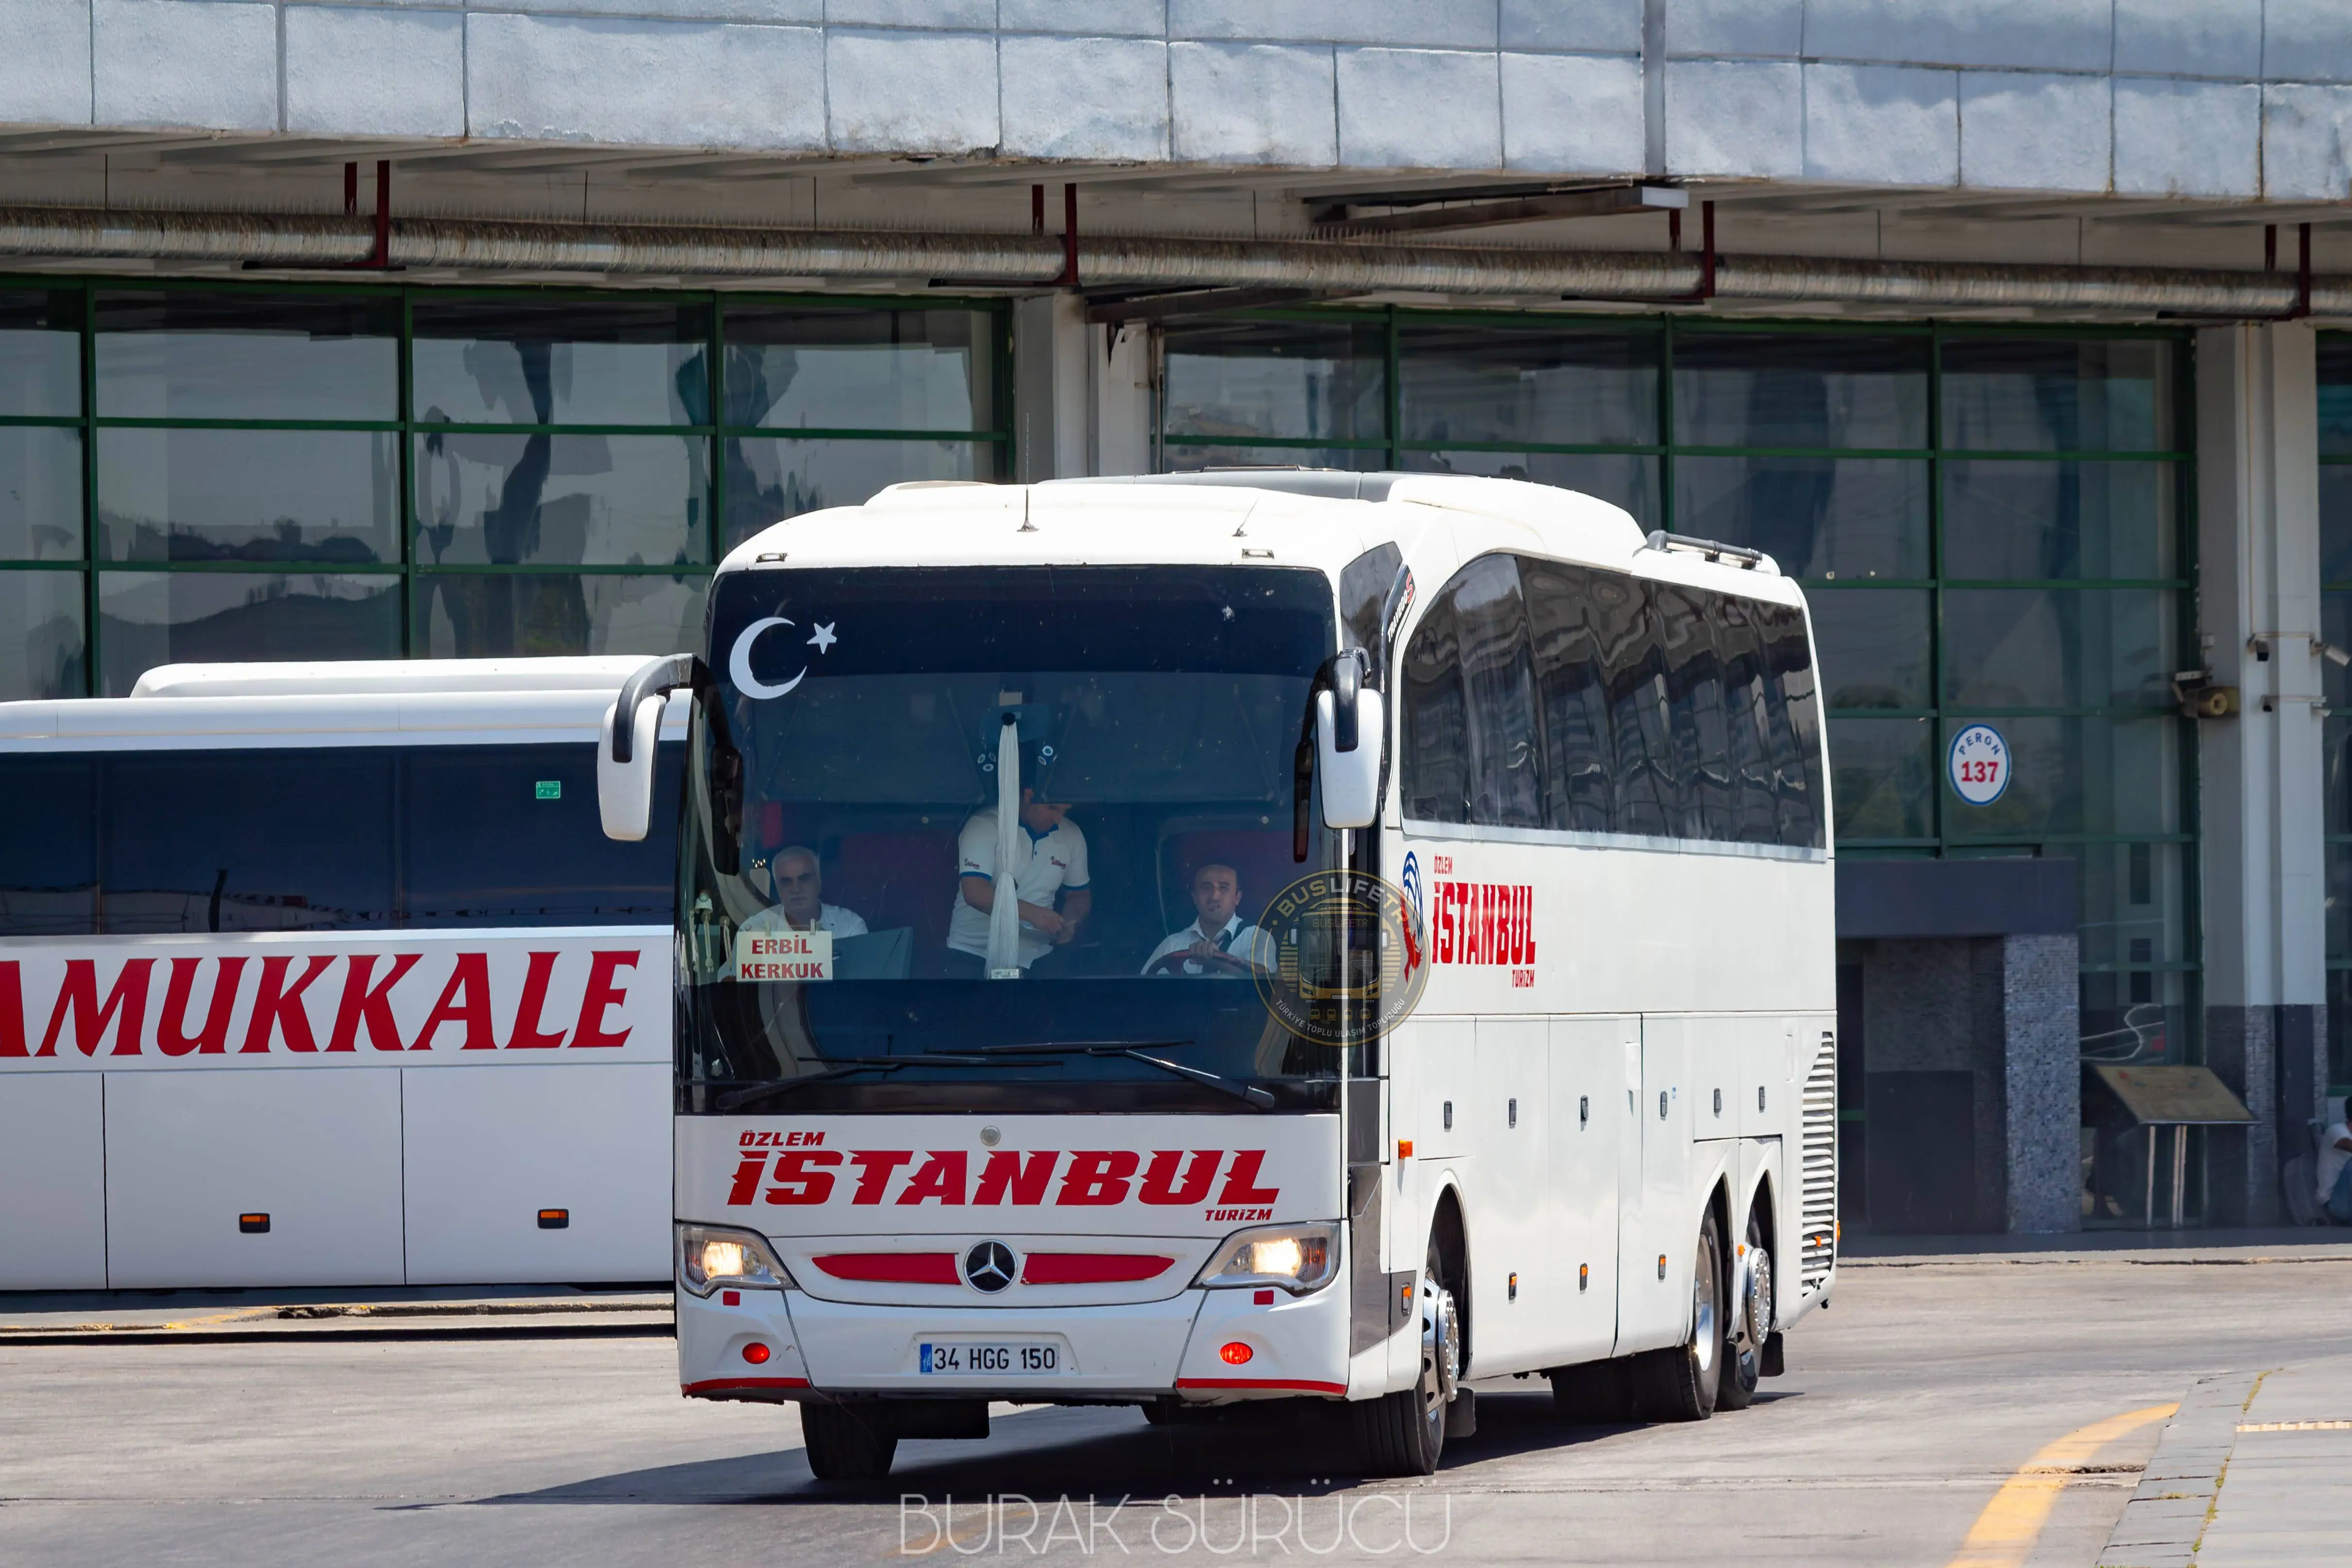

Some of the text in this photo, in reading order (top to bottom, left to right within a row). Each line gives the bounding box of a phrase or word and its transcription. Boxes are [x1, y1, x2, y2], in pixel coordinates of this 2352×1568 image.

[1958, 733, 2001, 755] PERON
[1961, 761, 1998, 783] 137
[1434, 854, 1453, 874] ÖZLEM
[752, 934, 813, 955] ERBİL
[741, 963, 824, 979] KERKUK
[739, 1130, 825, 1146] ÖZLEM
[727, 1150, 1280, 1205] İSTANBUL
[934, 1348, 960, 1370] 34
[970, 1348, 1009, 1370] HGG
[1020, 1348, 1055, 1369] 150
